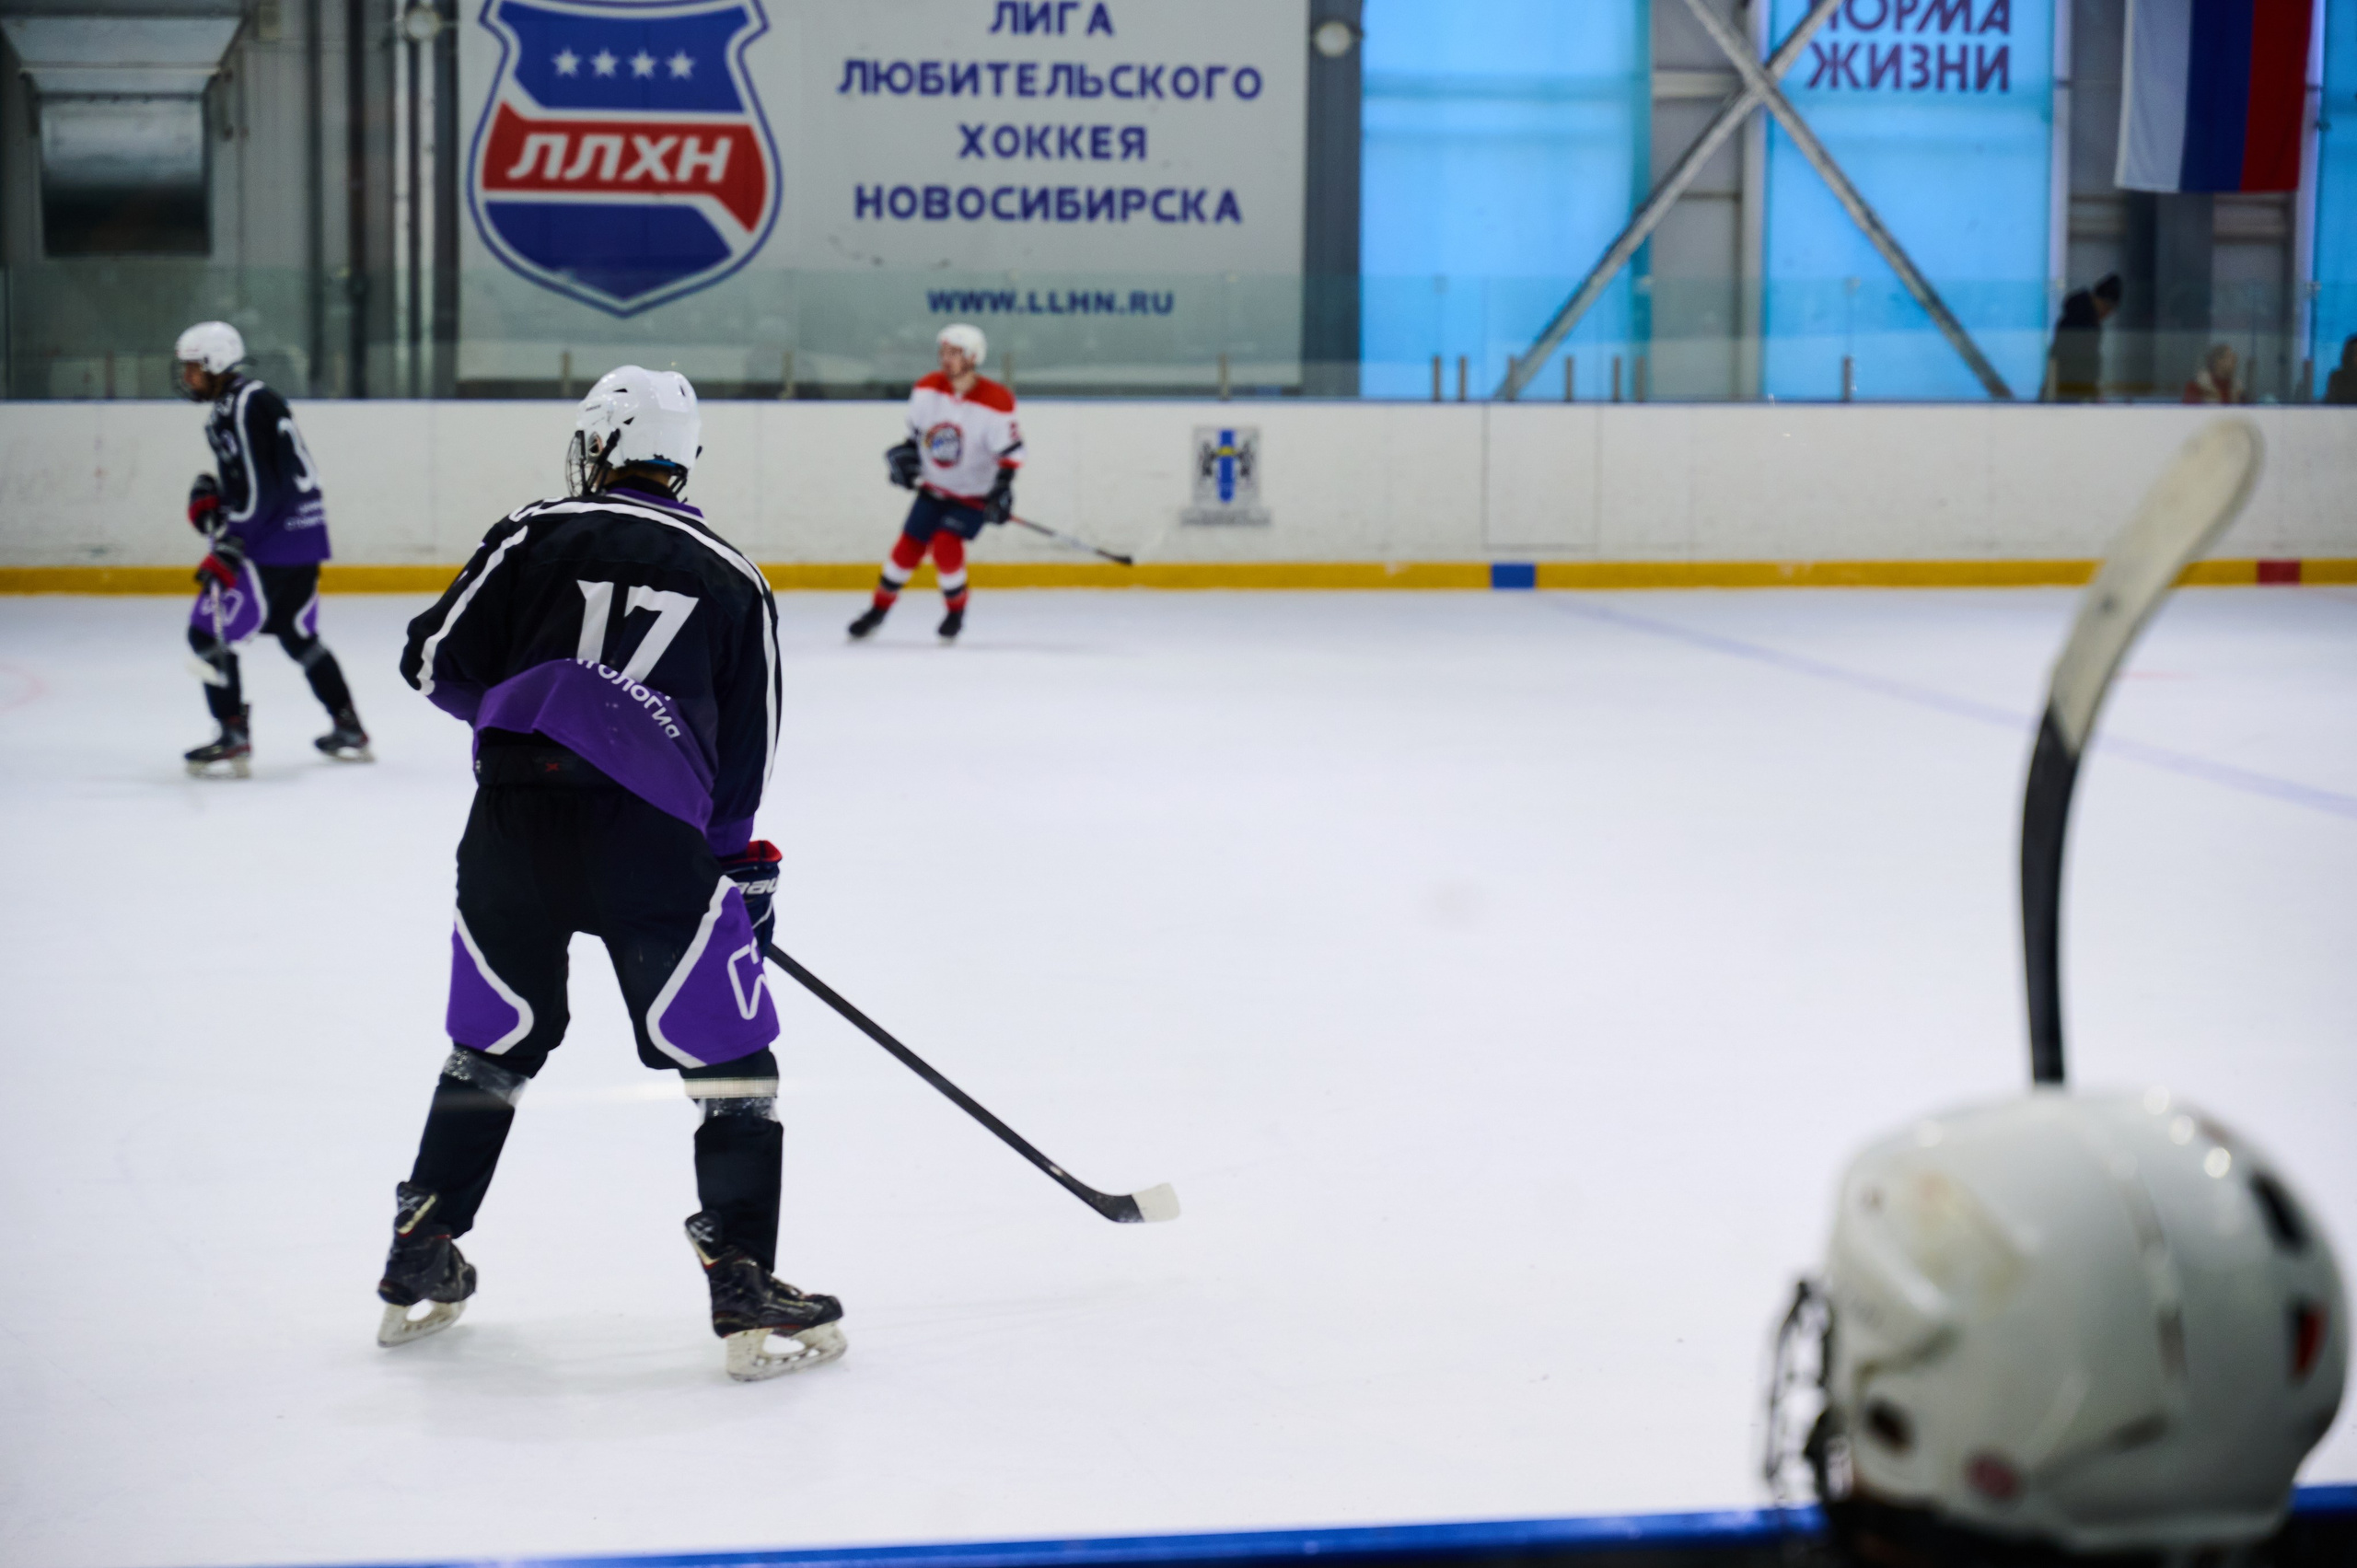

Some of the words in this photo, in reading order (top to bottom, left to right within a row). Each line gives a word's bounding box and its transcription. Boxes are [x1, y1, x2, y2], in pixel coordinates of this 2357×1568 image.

[988, 0, 1115, 36] ЛИГА
[837, 59, 1263, 100] ЛЮБИТЕЛЬСКОГО
[1805, 41, 2011, 93] ЖИЗНИ
[505, 133, 734, 183] ЛЛХН
[958, 123, 1148, 160] ХОККЕЯ
[853, 184, 1243, 224] НОВОСИБИРСКА
[925, 288, 1176, 316] WWW.LLHN.RU
[575, 579, 701, 684] 17
